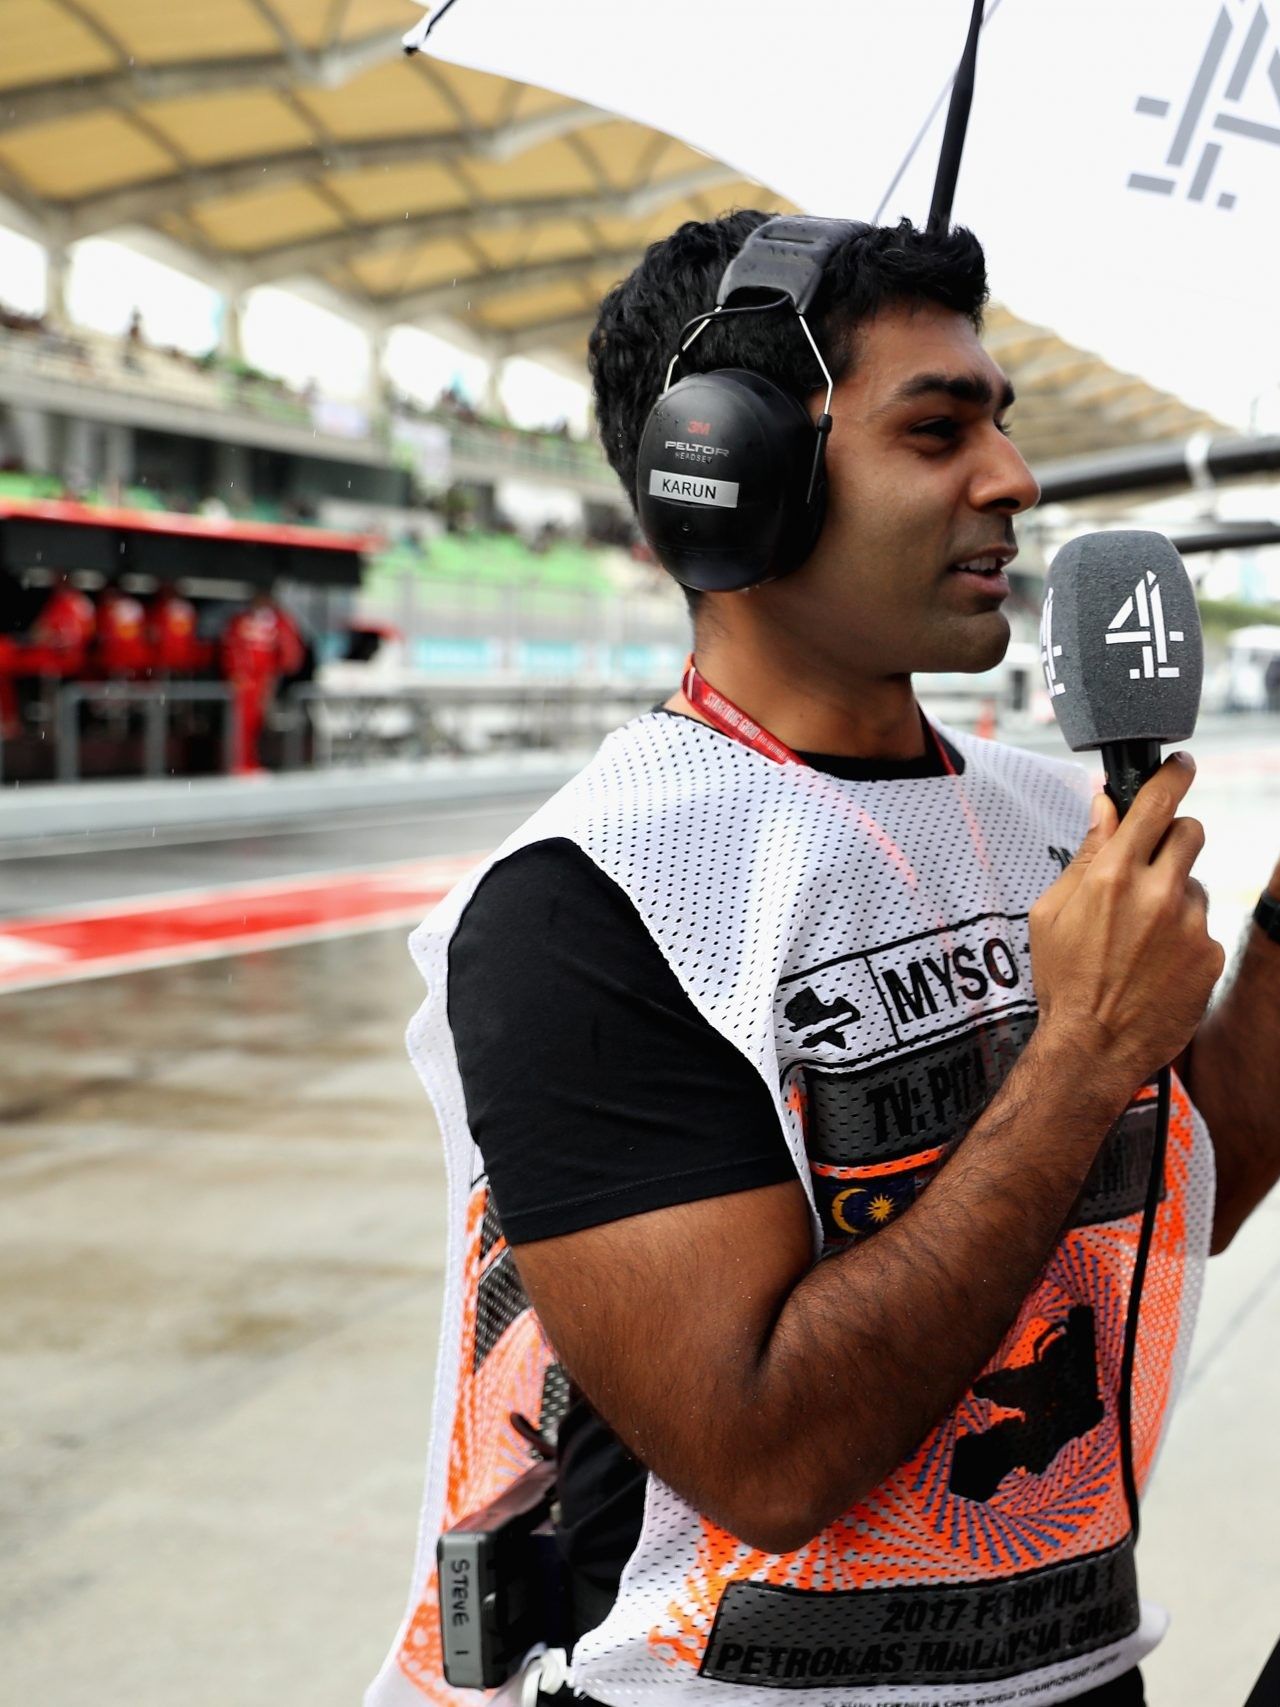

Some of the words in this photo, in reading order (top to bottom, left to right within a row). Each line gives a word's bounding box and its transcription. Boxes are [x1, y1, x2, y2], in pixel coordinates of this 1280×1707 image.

[687, 420, 712, 436] 3M
[664, 440, 730, 458] PELTOR
[674, 451, 713, 464] HEADSET
[661, 478, 717, 500] KARUN
[880, 1599, 970, 1634] 2017
